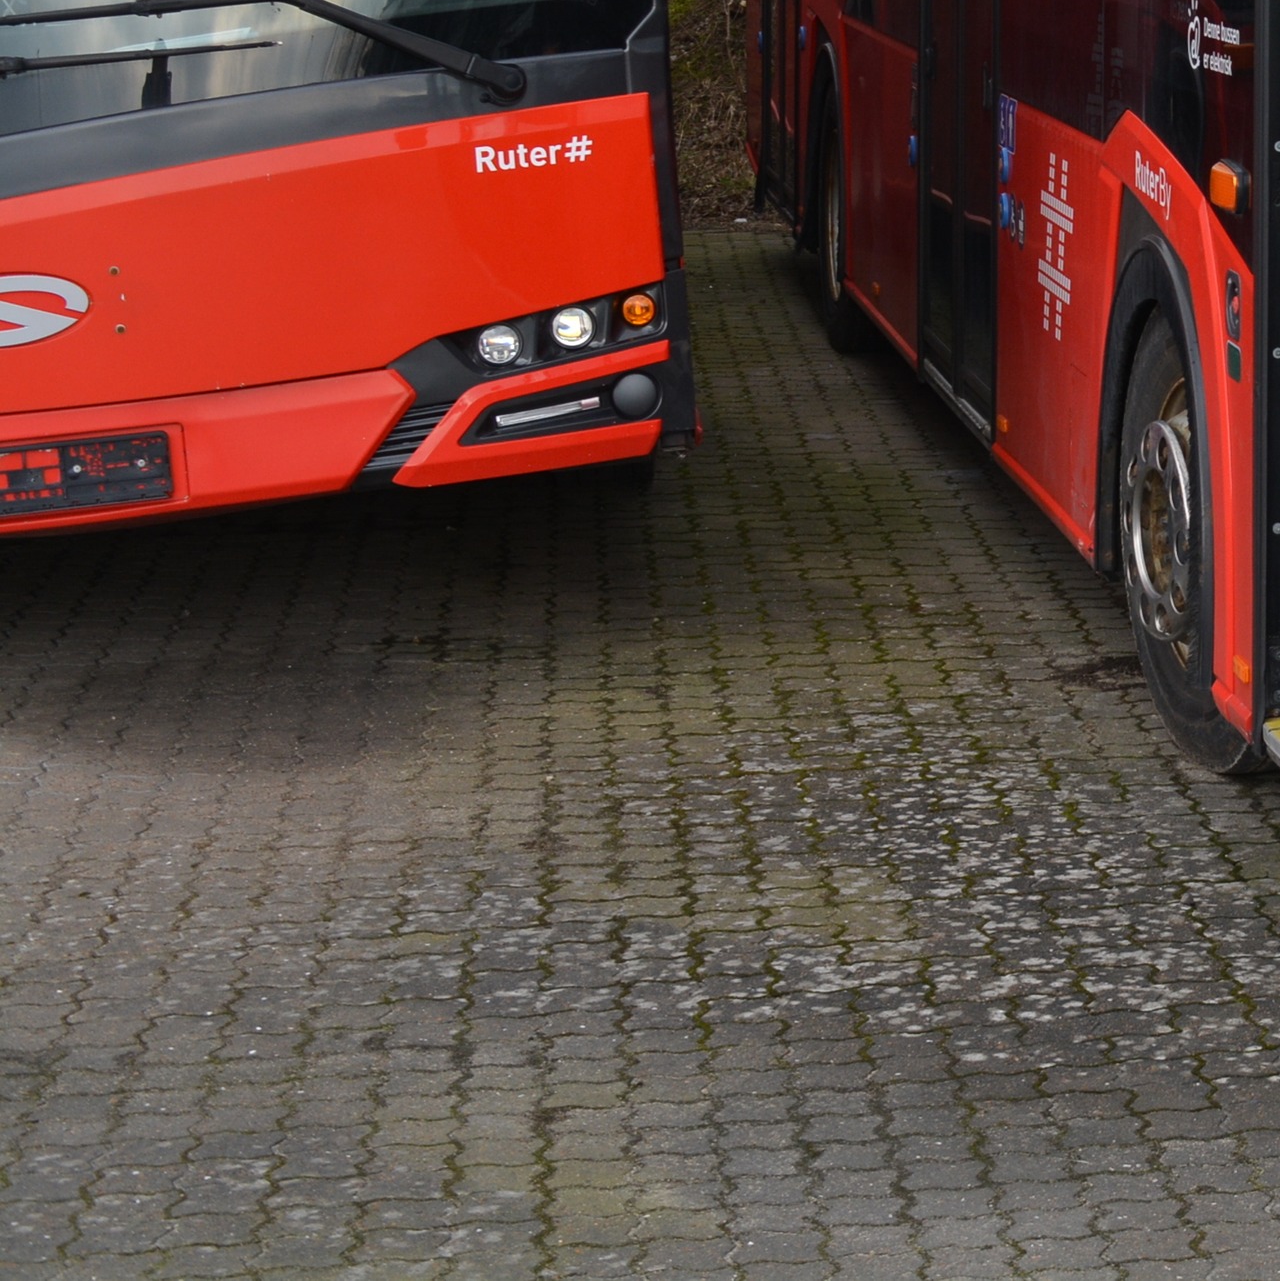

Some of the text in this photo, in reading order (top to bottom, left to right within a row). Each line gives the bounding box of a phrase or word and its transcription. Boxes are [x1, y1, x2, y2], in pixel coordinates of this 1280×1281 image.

[1203, 16, 1240, 46] Denne bussen
[1203, 51, 1232, 76] er elektrisk
[474, 135, 593, 173] Ruter#
[1134, 149, 1172, 221] RuterBy
